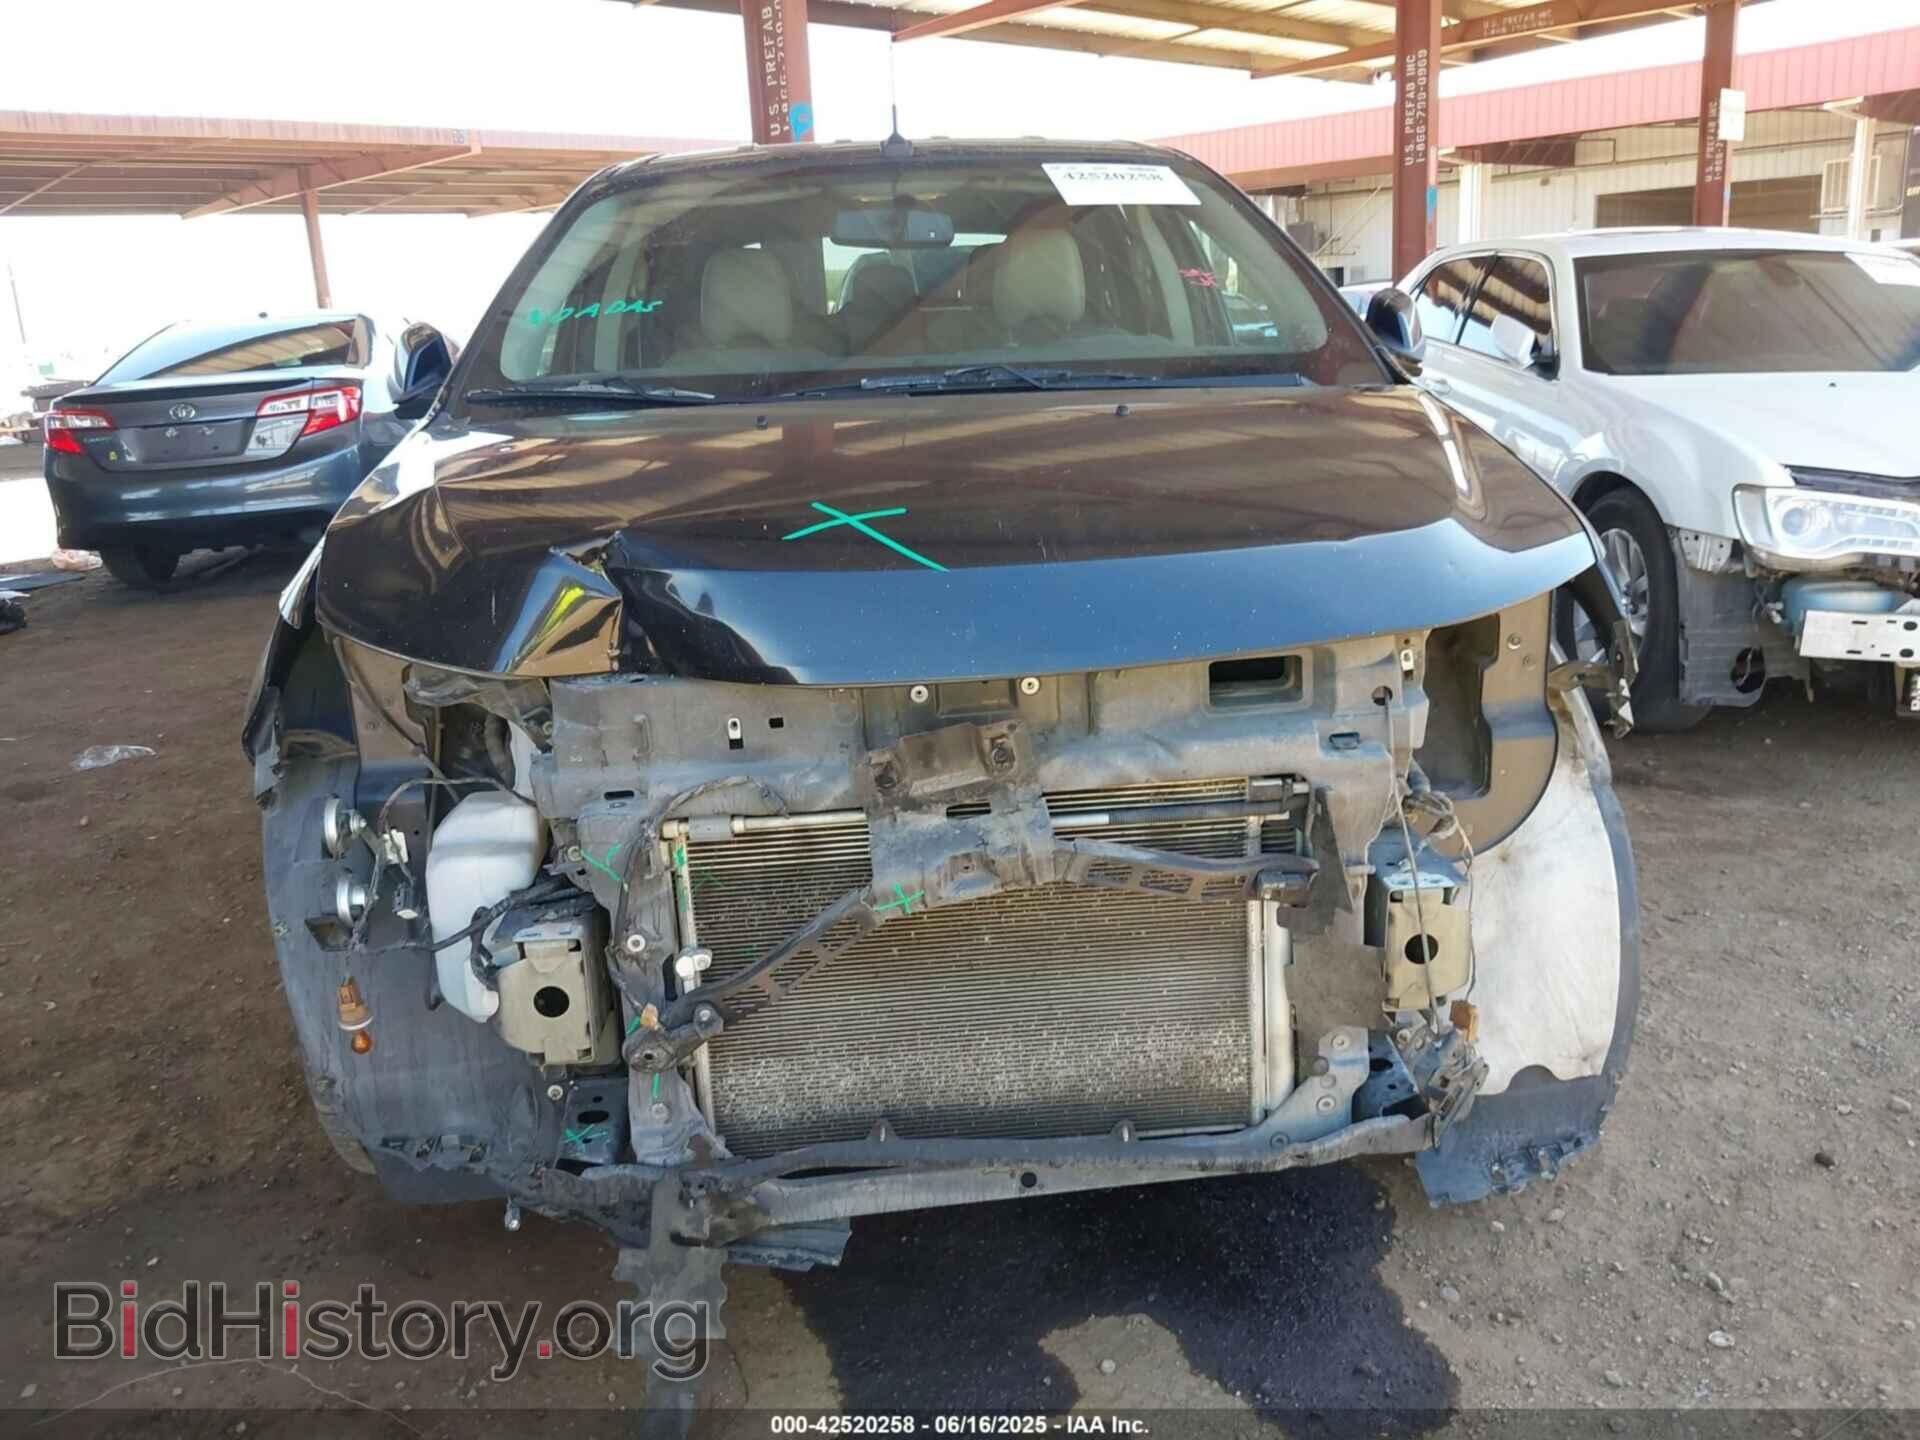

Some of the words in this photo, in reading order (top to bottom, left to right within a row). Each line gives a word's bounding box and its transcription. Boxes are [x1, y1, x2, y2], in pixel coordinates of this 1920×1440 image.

[762, 6, 778, 86] PREFAB
[1406, 55, 1416, 77] INC
[768, 97, 781, 136] U.S.
[1405, 82, 1416, 134] PREFAB
[1404, 139, 1415, 166] U.S.
